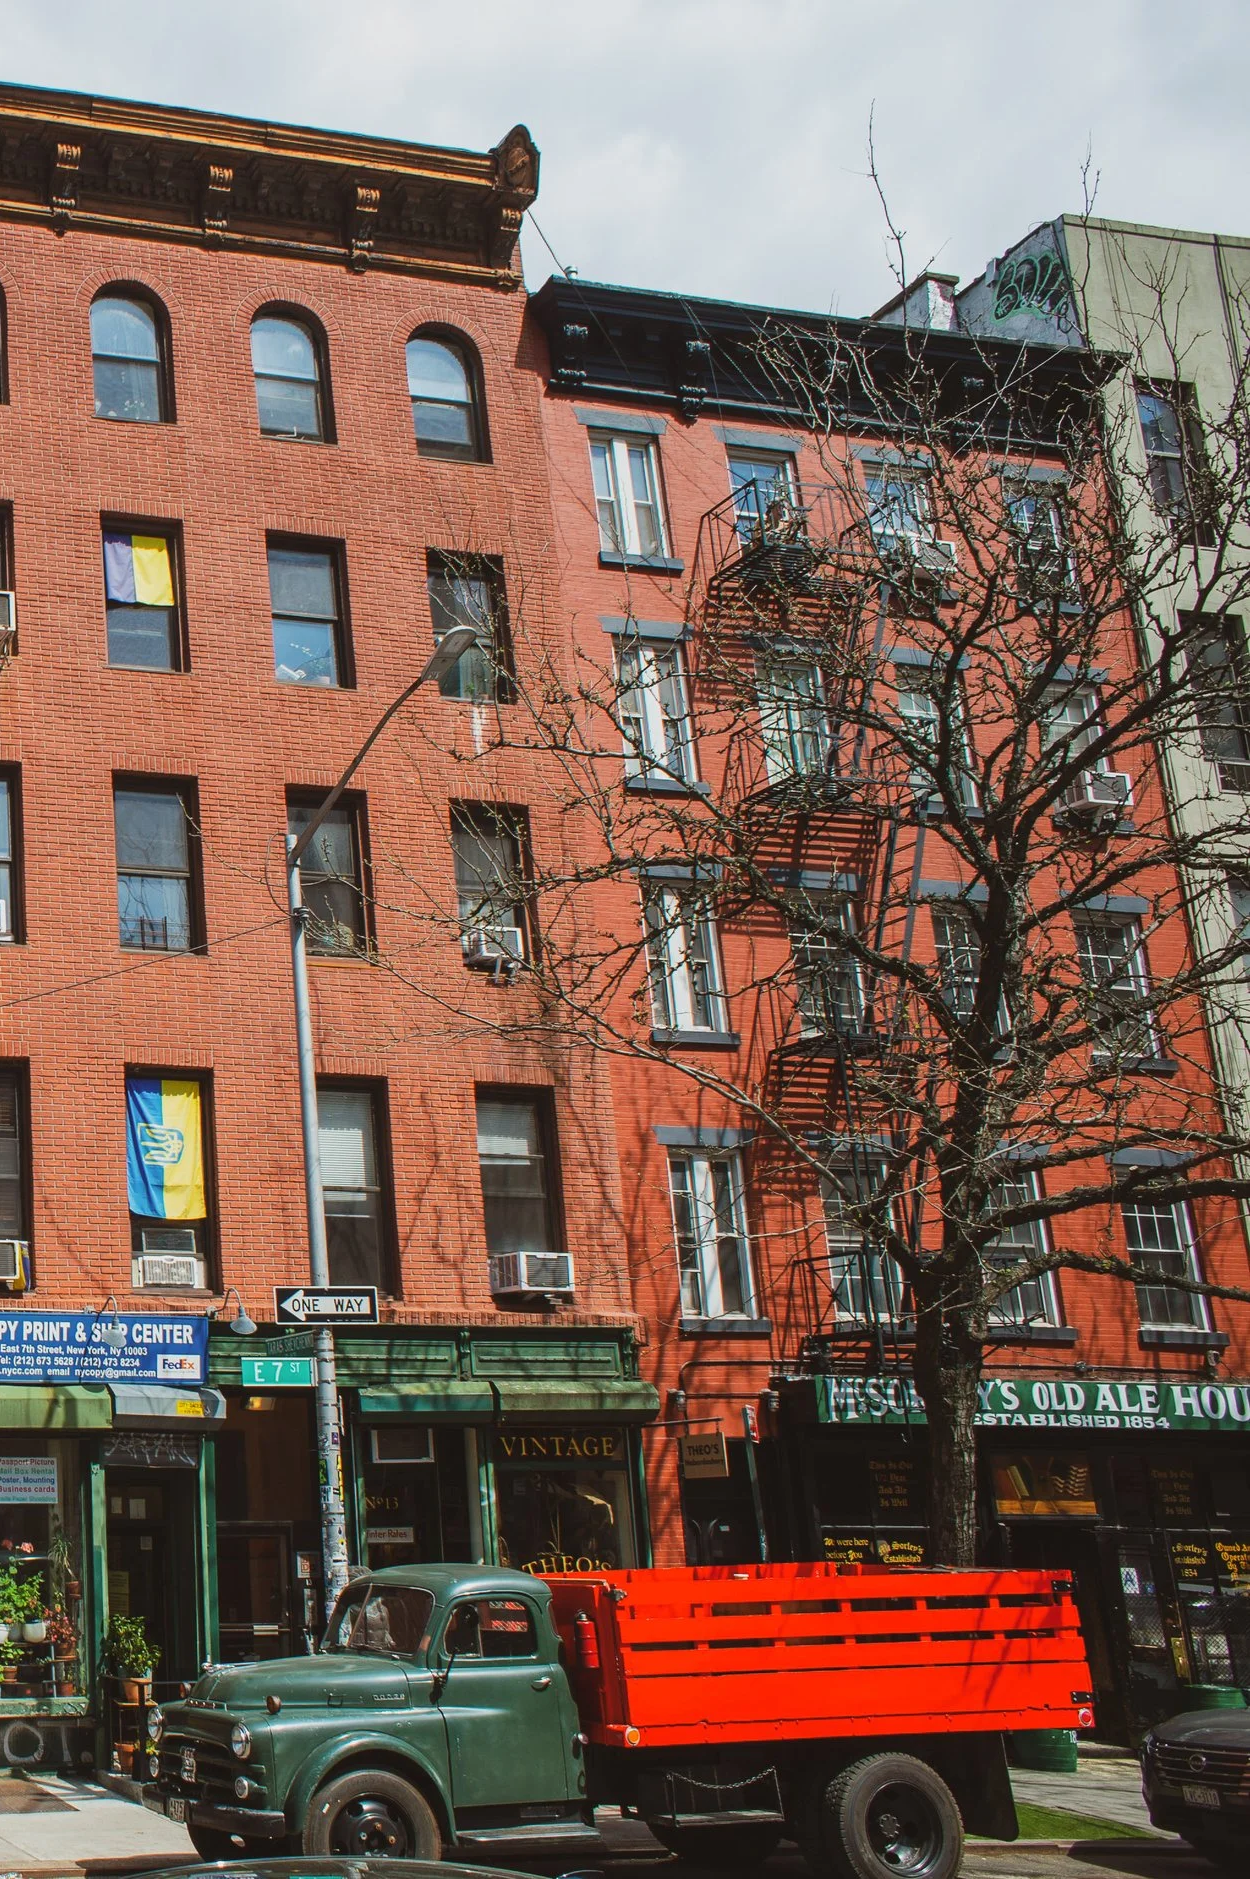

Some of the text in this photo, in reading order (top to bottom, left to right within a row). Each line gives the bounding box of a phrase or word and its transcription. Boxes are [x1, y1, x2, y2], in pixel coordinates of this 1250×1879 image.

[291, 1298, 364, 1312] ONE WAY
[22, 1321, 71, 1342] PRINT
[75, 1322, 86, 1342] &
[91, 1323, 129, 1343] SHP
[131, 1323, 194, 1344] CENTER
[0, 1344, 20, 1353] East
[21, 1344, 35, 1354] 7th
[36, 1345, 65, 1355] Street,
[66, 1346, 85, 1355] New
[86, 1346, 108, 1356] York,
[110, 1346, 122, 1357] Ny
[123, 1346, 148, 1356] 10003
[13, 1356, 35, 1366] (212)
[36, 1356, 52, 1366] 673
[53, 1357, 74, 1366] 5628
[80, 1357, 101, 1367] (212)
[102, 1358, 118, 1367] 473
[120, 1358, 140, 1367] 8234
[162, 1358, 195, 1370] FedEx
[47, 1366, 70, 1376] email
[74, 1368, 157, 1379] nycopy@gmail.com
[253, 1362, 301, 1382] E 7 ST
[1031, 1381, 1086, 1412] OLD
[1093, 1382, 1161, 1415] ALE
[972, 1413, 1171, 1430] ESTABLISHED 1854
[500, 1436, 615, 1457] VINTAGE
[687, 1443, 720, 1456] THEO'S
[14, 1467, 29, 1475] Box
[31, 1467, 55, 1475] Rental
[22, 1476, 55, 1485] Mounting
[33, 1485, 55, 1493] cards
[366, 1529, 386, 1538] inter
[836, 1538, 853, 1546] were
